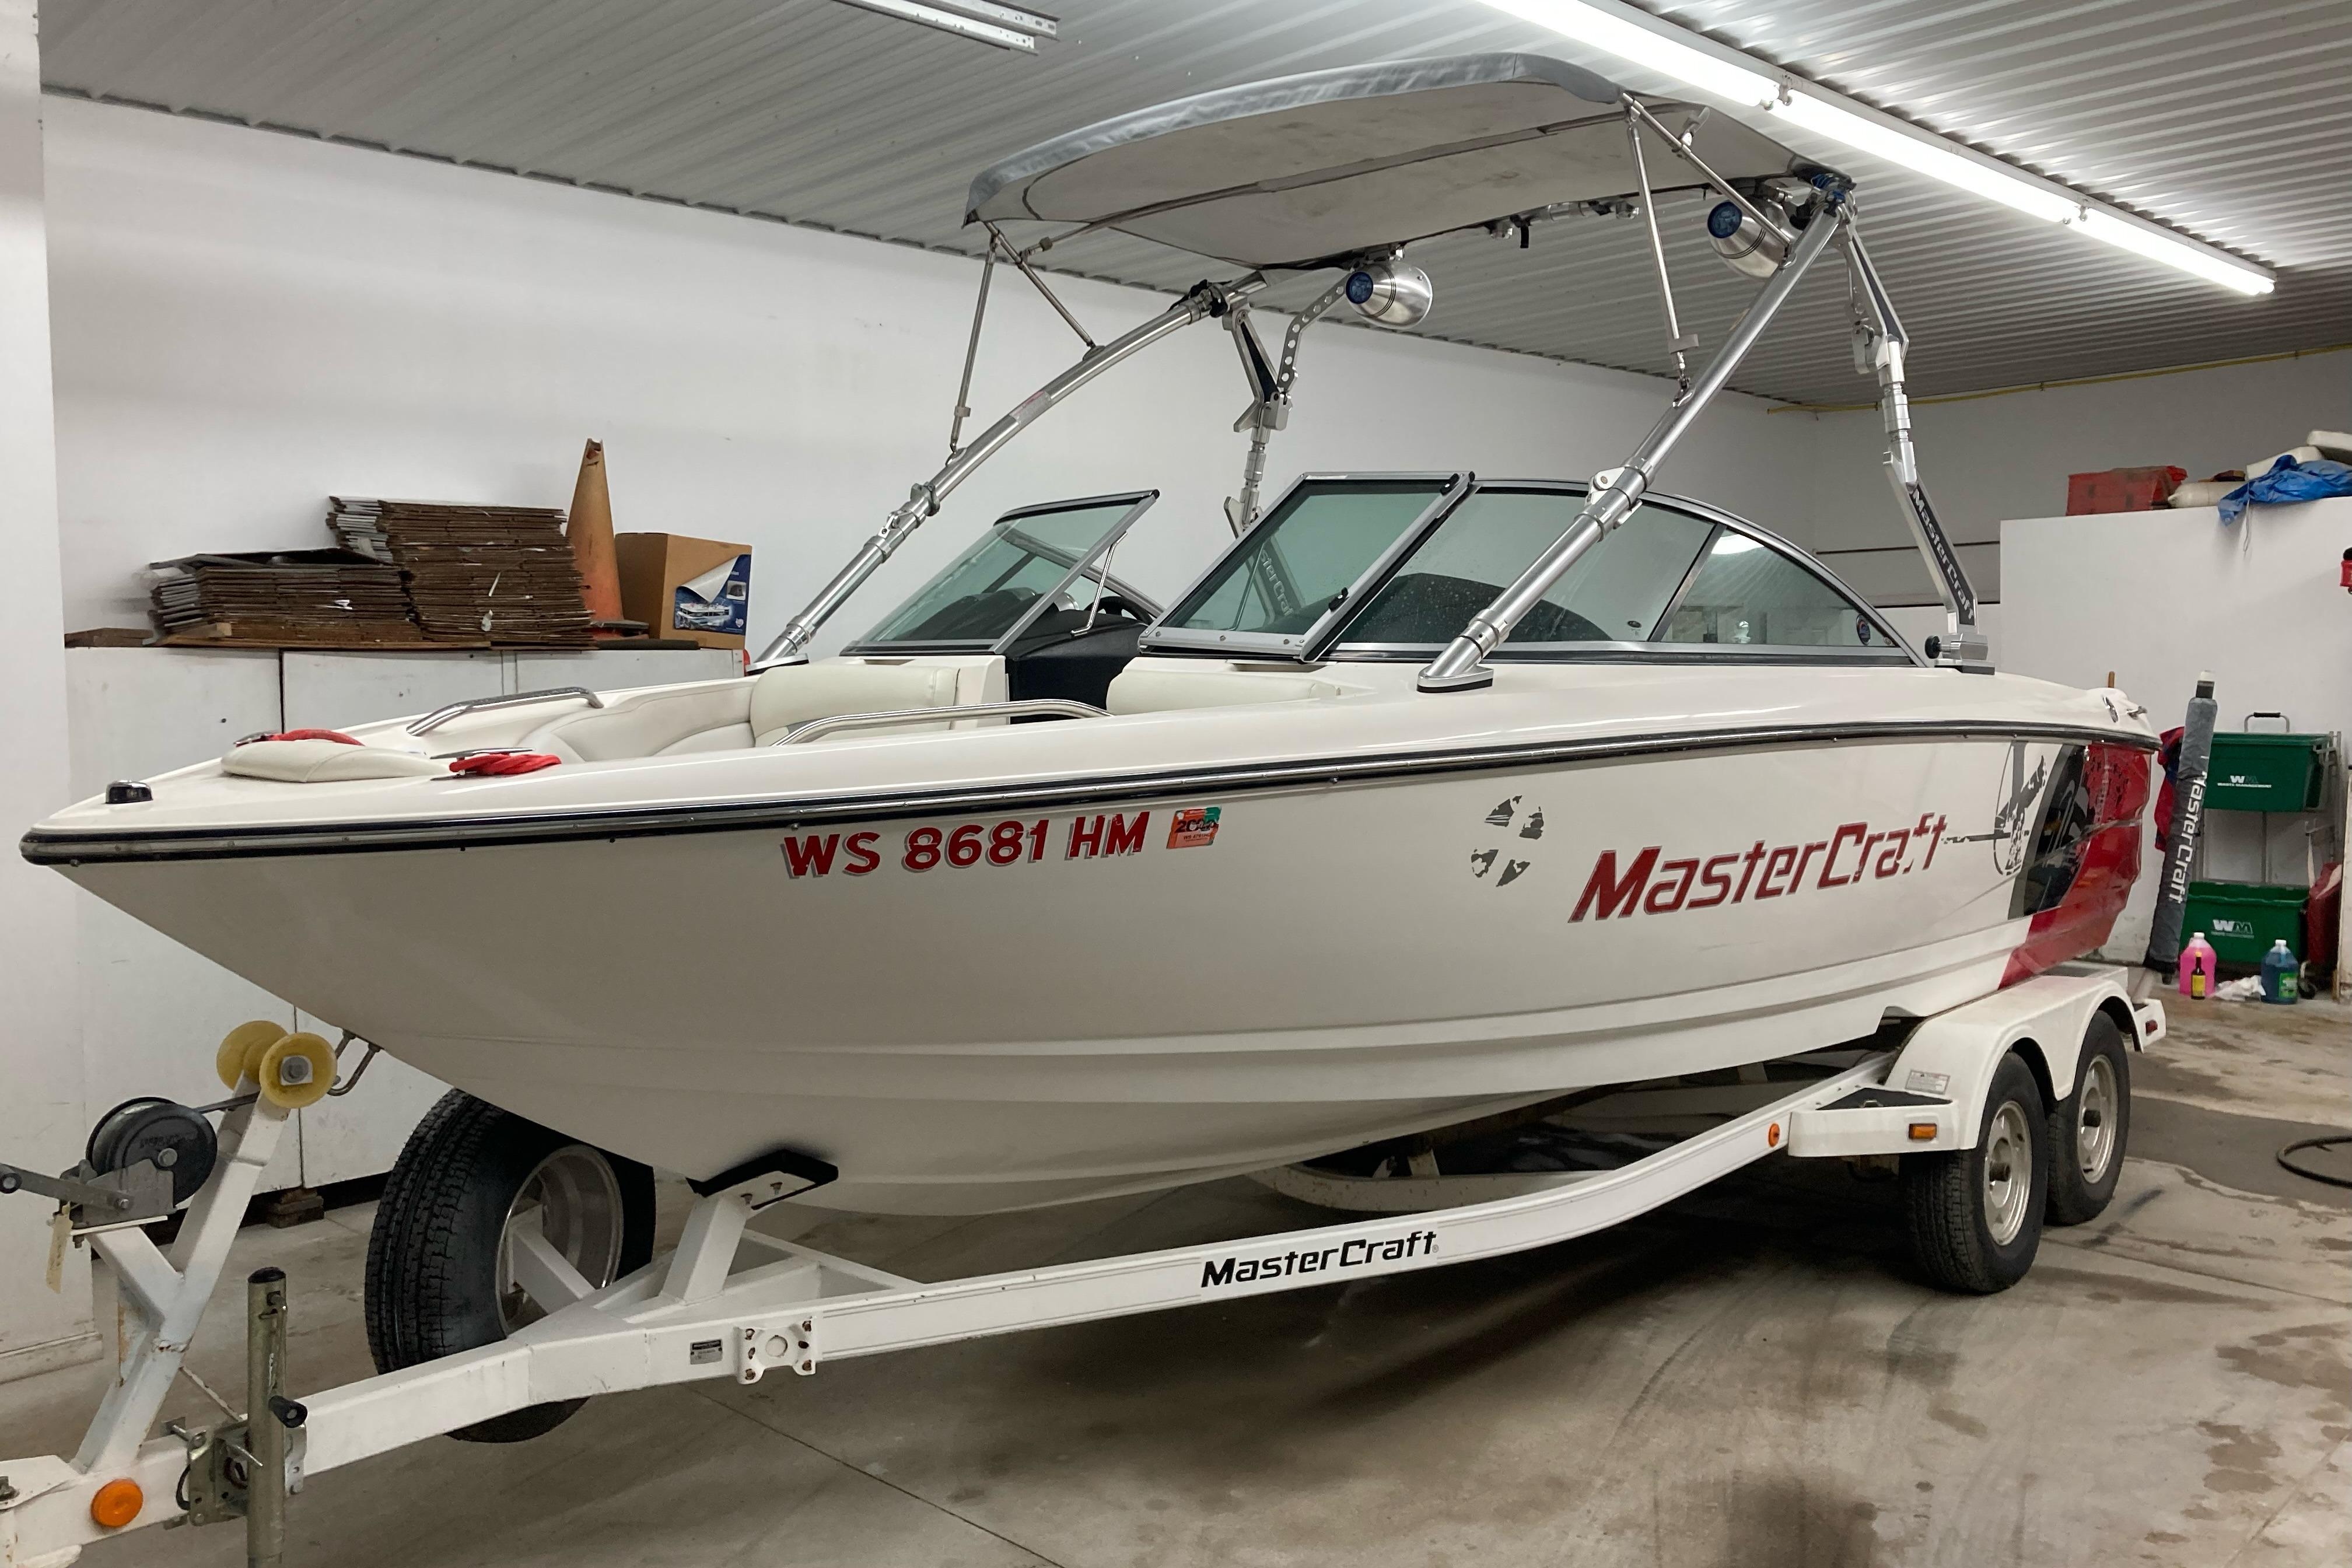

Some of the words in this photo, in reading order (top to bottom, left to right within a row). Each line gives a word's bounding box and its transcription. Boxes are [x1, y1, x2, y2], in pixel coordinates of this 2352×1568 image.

[1259, 549, 1294, 617] sterCraf
[1912, 488, 1975, 621] MasterCraft
[780, 831, 881, 879] WS
[901, 819, 1049, 874] 8681
[1063, 811, 1151, 861] HM
[1567, 812, 1948, 924] MasterCraft
[2213, 919, 2253, 935] WM
[1200, 1230, 1437, 1288] MasterCraft
